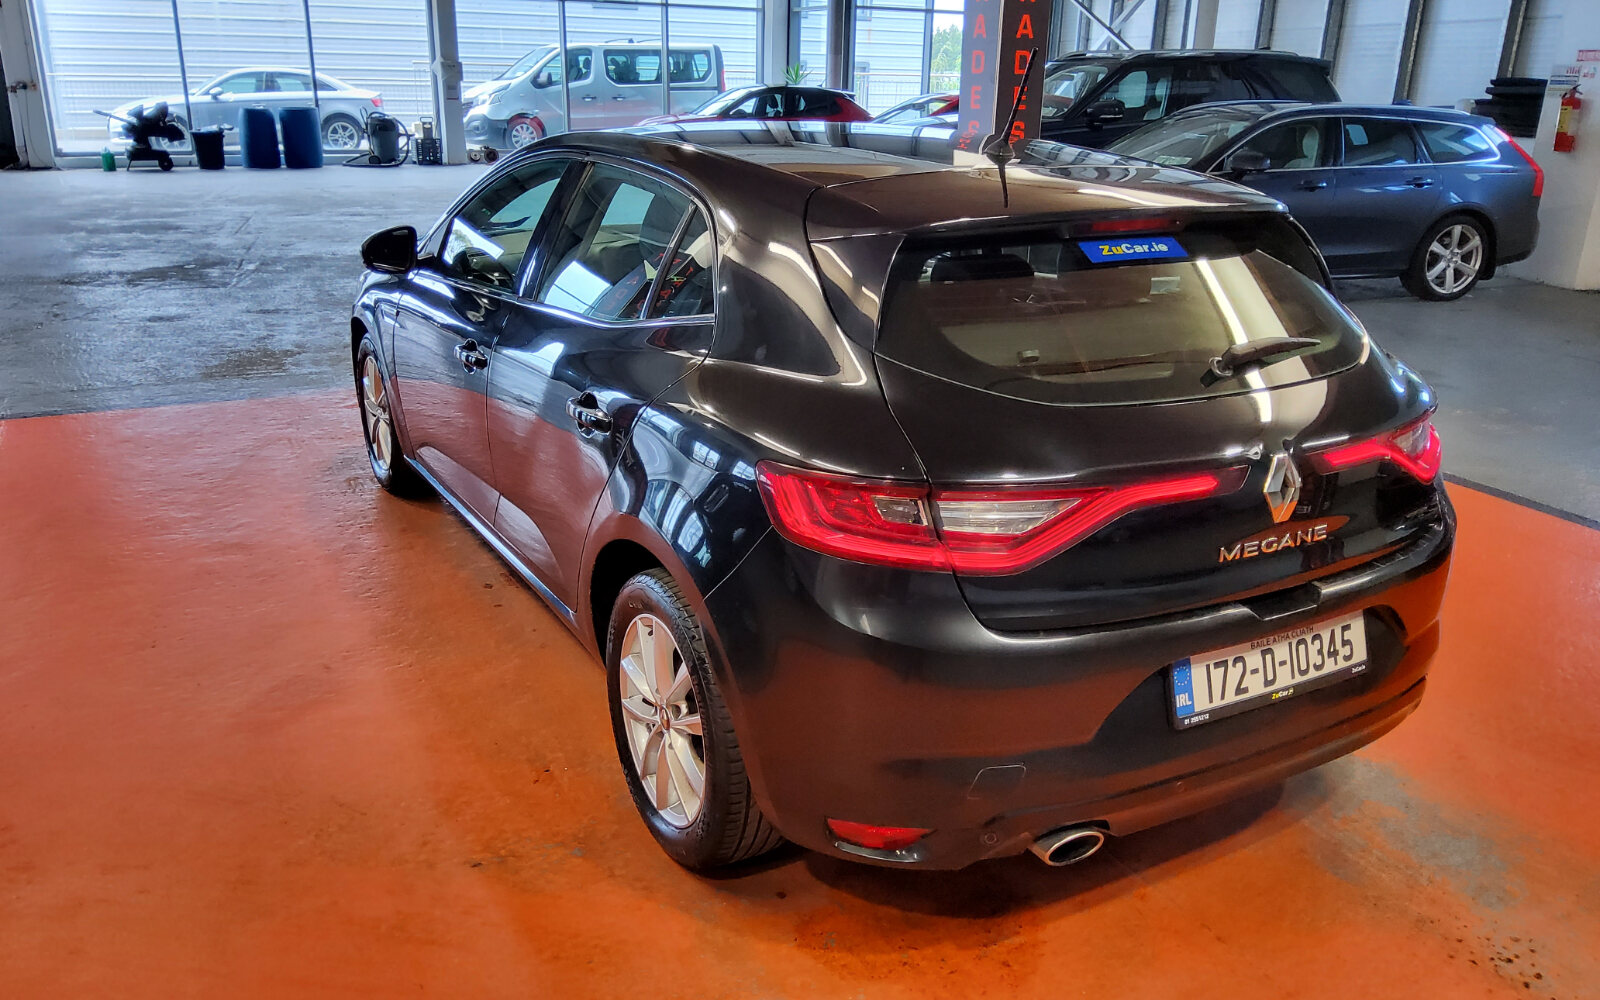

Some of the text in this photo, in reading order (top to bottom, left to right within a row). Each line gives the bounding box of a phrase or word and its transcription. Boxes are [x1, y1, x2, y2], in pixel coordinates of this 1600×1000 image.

[1099, 242, 1169, 255] ZuCar.ie
[1219, 523, 1328, 562] MEGANE
[1250, 638, 1271, 650] BAILE
[1290, 626, 1314, 639] CLIATH
[1205, 623, 1354, 704] 172-D-10345
[1175, 692, 1192, 708] IRL
